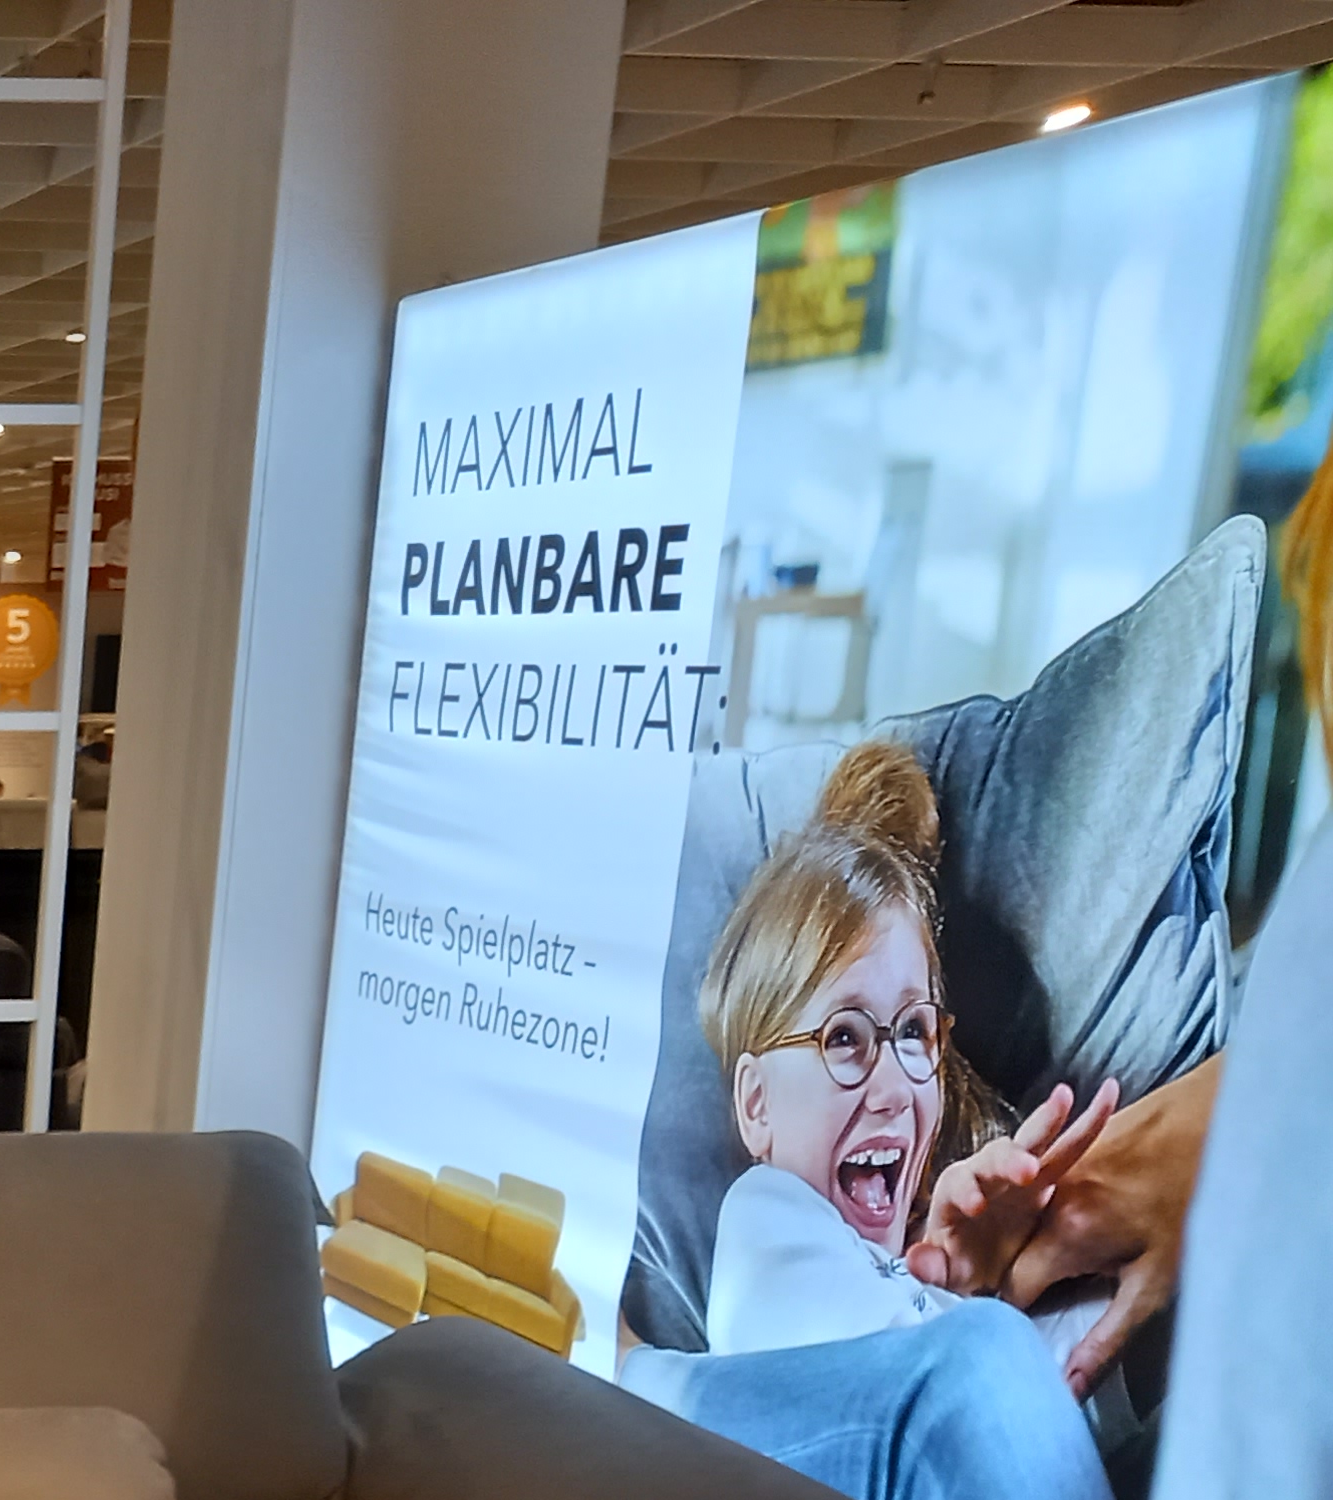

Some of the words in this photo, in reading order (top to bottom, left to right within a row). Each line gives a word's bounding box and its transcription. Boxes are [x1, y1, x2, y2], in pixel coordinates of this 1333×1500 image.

[412, 387, 654, 498] MAXIMAL
[399, 523, 691, 616] PLANBARE
[6, 607, 31, 644] 5
[388, 642, 728, 756] FLEXIBILITÄT:
[364, 890, 434, 949] Heute
[441, 906, 576, 980] Spielplatz
[357, 964, 452, 1027] morgen
[457, 975, 612, 1063] Ruhezone!
